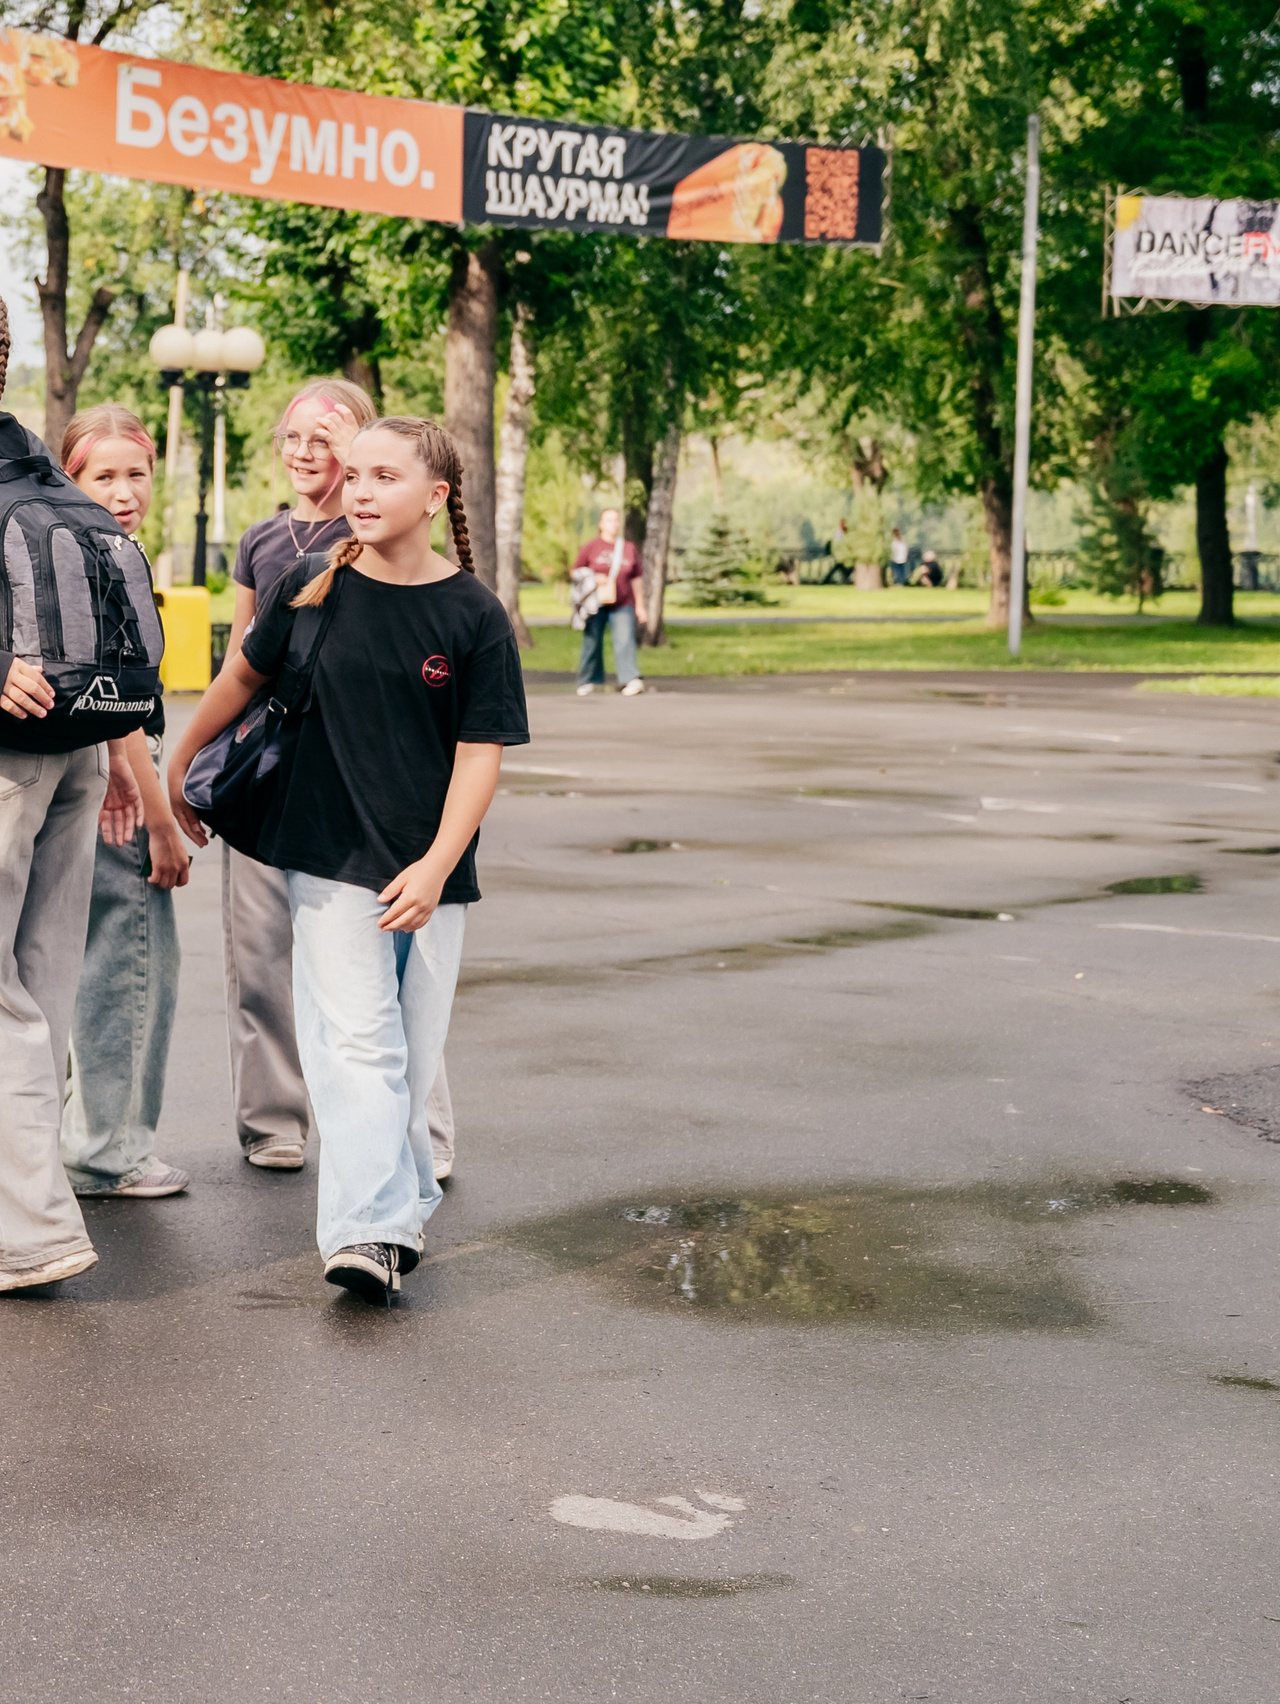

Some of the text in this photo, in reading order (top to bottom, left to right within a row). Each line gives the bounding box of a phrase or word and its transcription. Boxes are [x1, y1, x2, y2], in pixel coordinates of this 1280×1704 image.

[116, 63, 435, 189] Безумно.
[487, 122, 627, 179] КРУТАЯ
[485, 169, 651, 226] ШАУРМА!
[77, 695, 153, 712] Dominanta
